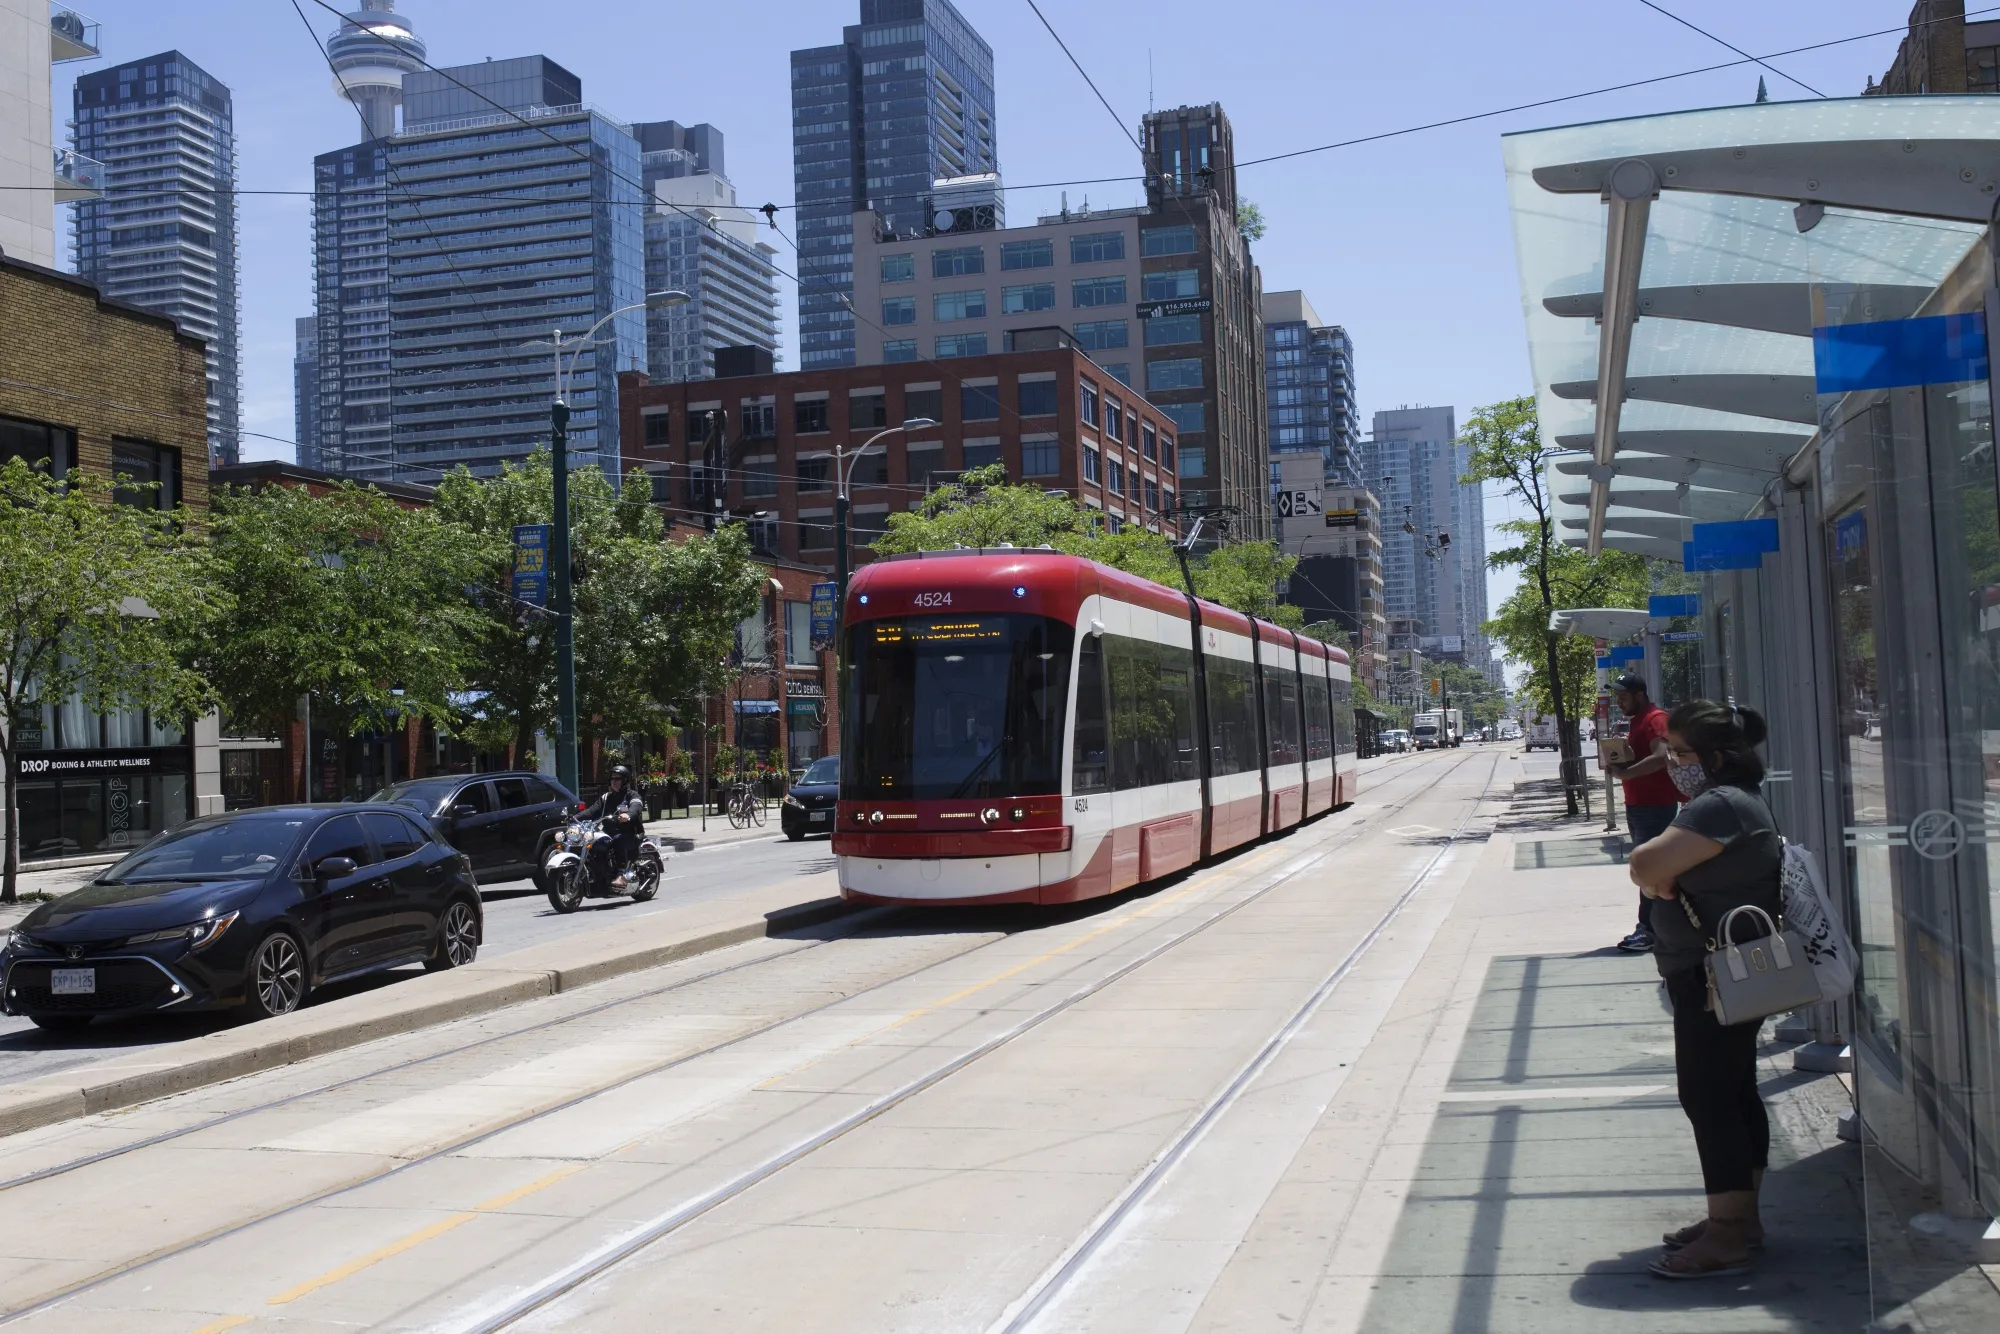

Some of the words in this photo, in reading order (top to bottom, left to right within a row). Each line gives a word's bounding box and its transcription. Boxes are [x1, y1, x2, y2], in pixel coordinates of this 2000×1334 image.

[515, 564, 543, 573] AWAY
[914, 592, 953, 607] 4524
[604, 735, 625, 750] fresh
[21, 760, 50, 773] DROP
[51, 761, 79, 769] BOXING
[86, 760, 118, 768] ATHLETIC
[119, 758, 151, 767] WELLNESS
[108, 777, 129, 844] DROP
[1075, 797, 1089, 813] 4524
